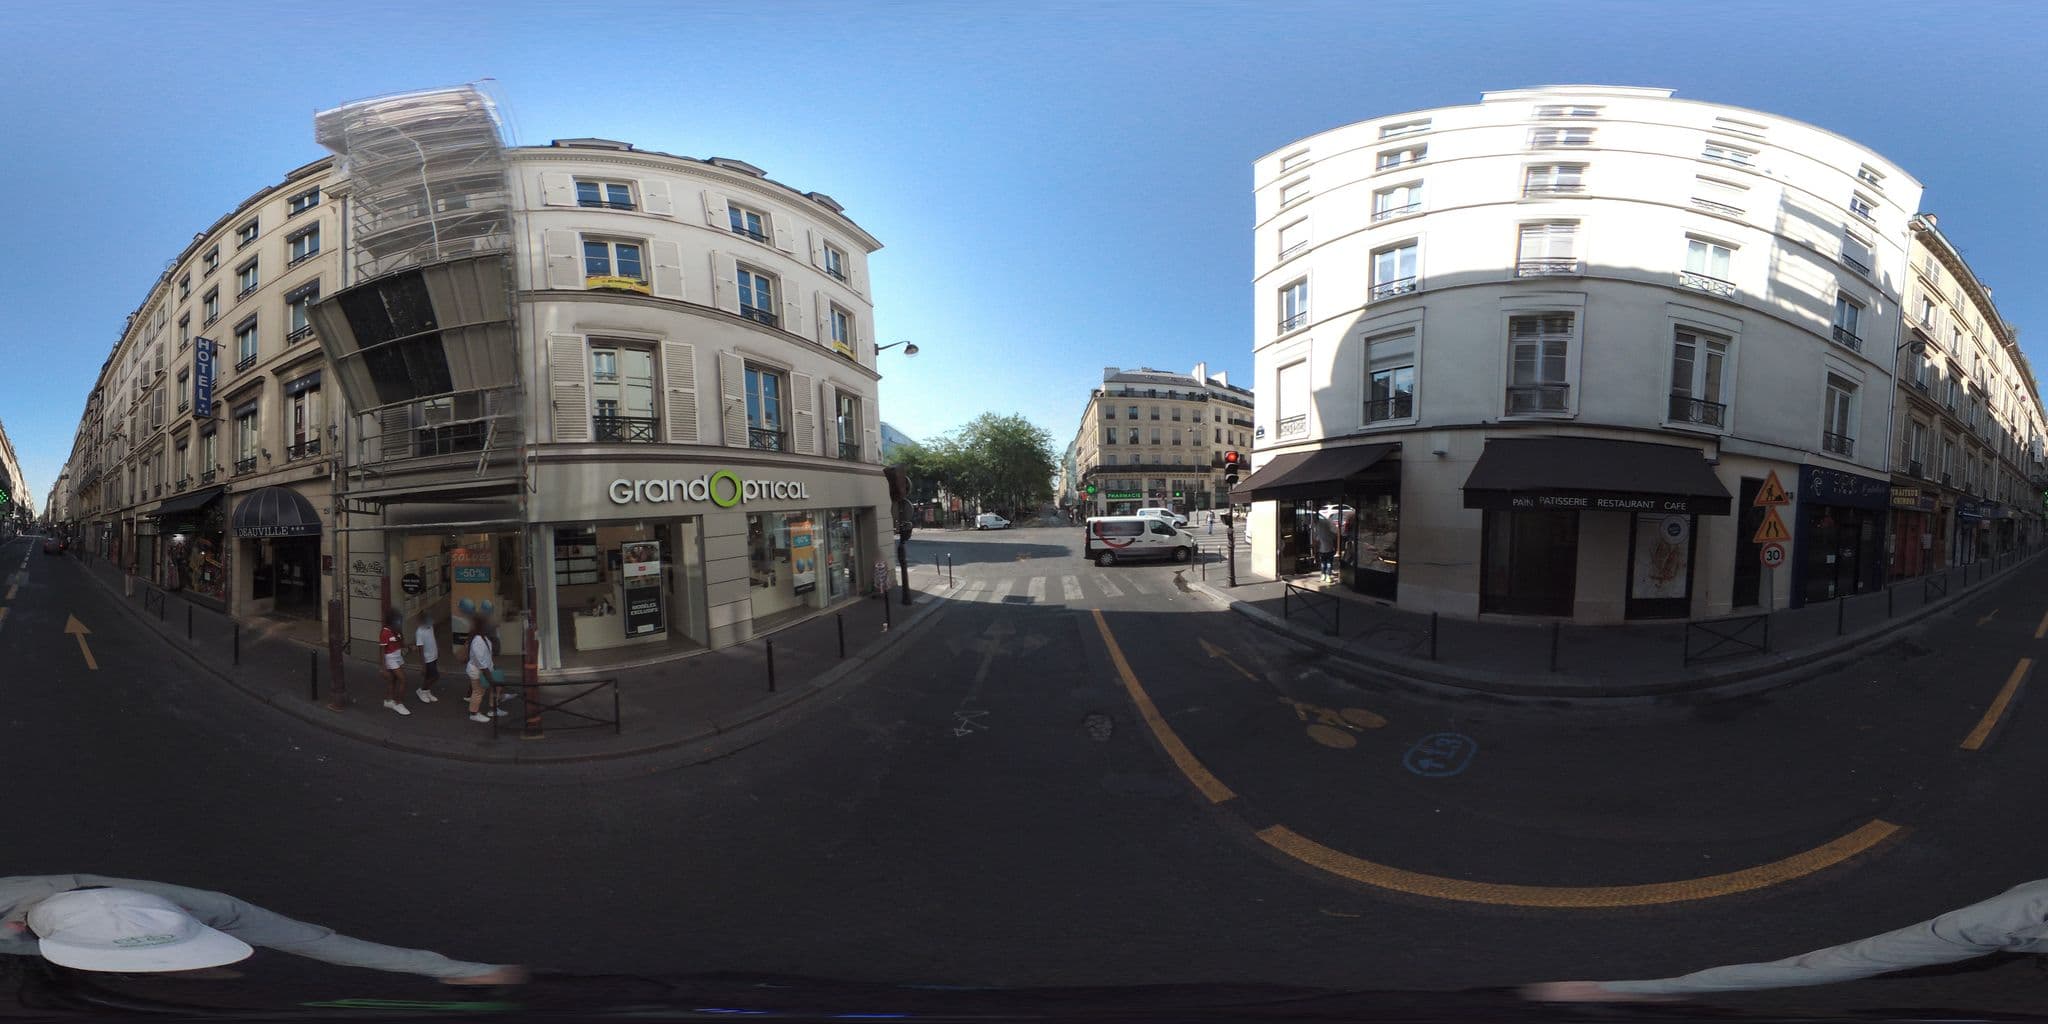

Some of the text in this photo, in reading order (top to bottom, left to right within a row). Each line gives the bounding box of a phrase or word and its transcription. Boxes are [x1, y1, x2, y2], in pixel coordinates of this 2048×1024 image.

[198, 339, 210, 401] HOTEL
[1512, 498, 1534, 507] PAIN
[1539, 496, 1588, 506] PATISSERIE
[1597, 498, 1656, 509] RESTAURANT
[239, 526, 289, 537] DEAUVILLE
[1766, 550, 1780, 561] 30
